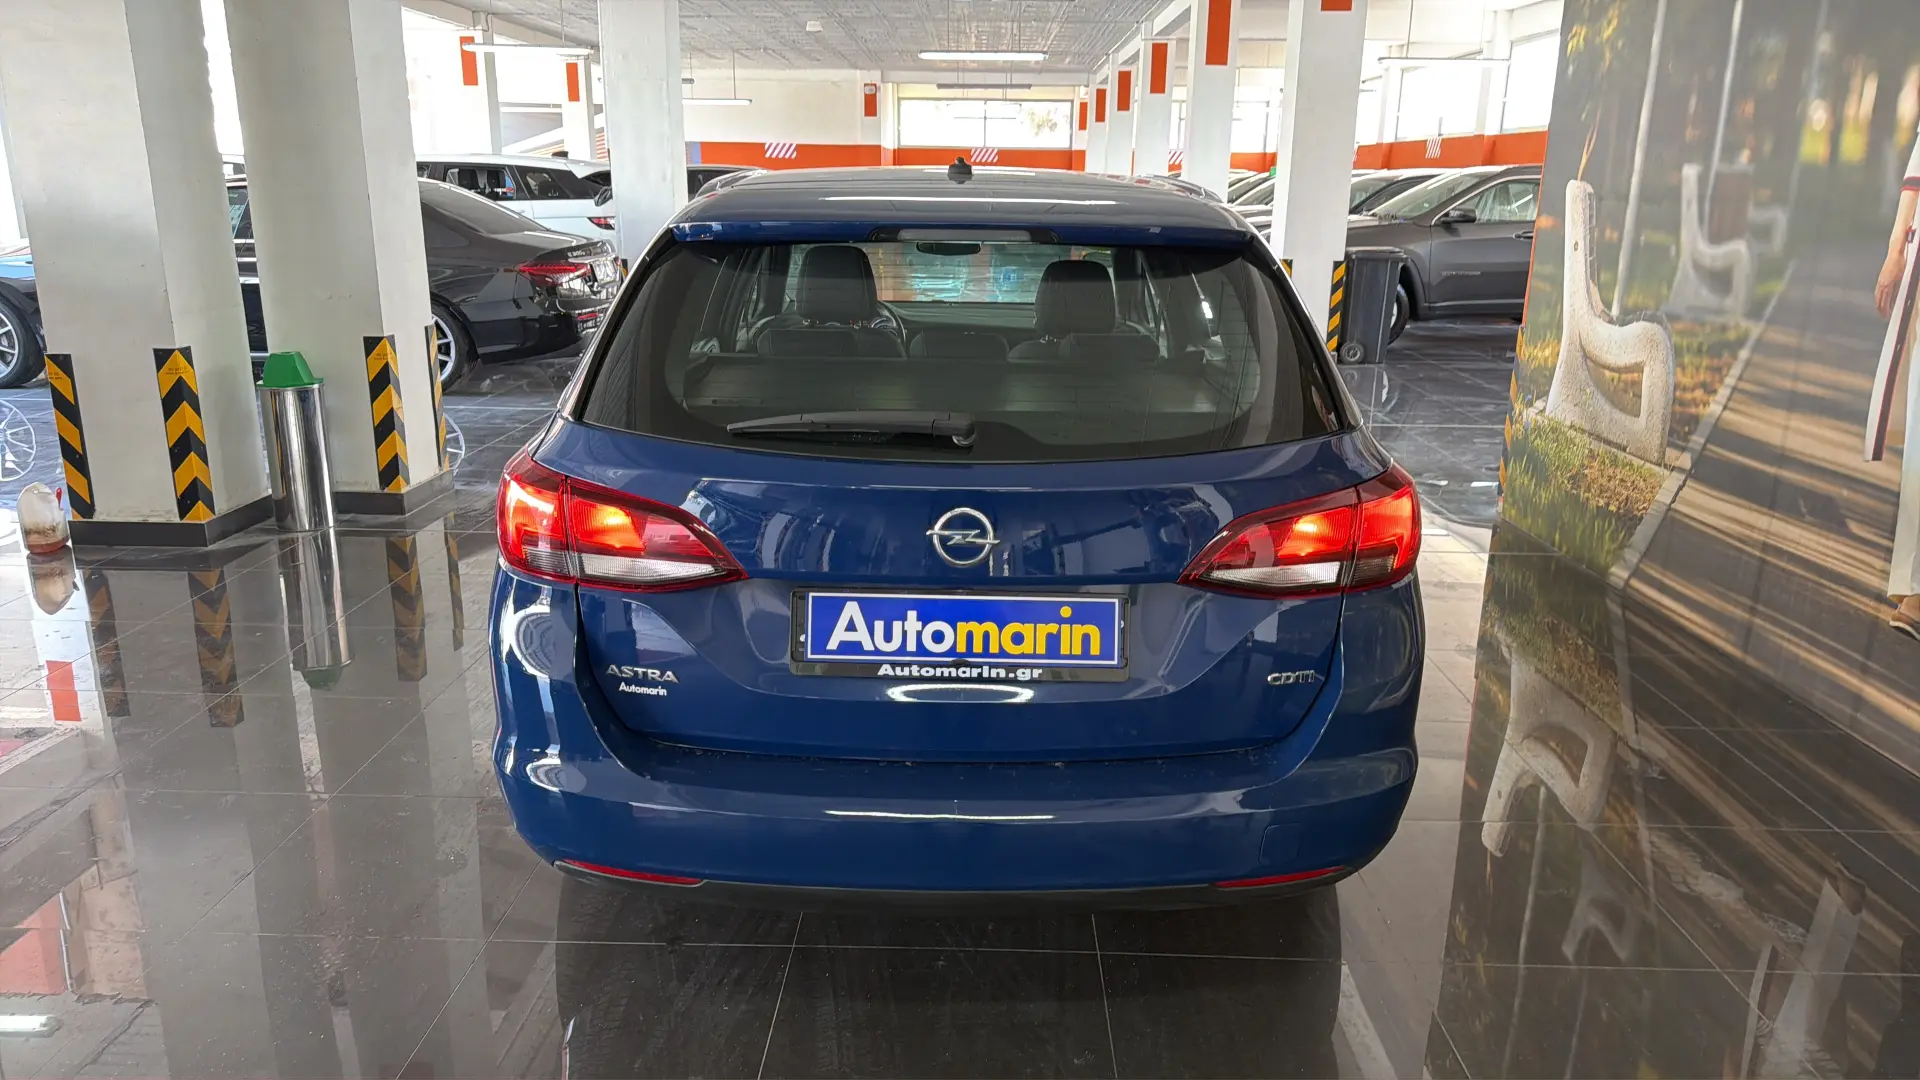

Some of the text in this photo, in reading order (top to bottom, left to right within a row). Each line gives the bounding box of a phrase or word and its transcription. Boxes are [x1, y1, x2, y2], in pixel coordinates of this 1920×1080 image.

[826, 600, 1101, 656] Automarin
[606, 664, 679, 683] ASTRA
[877, 663, 1043, 681] Automarin.gr
[1267, 670, 1315, 685] CDTI
[619, 681, 667, 696] Automarin
